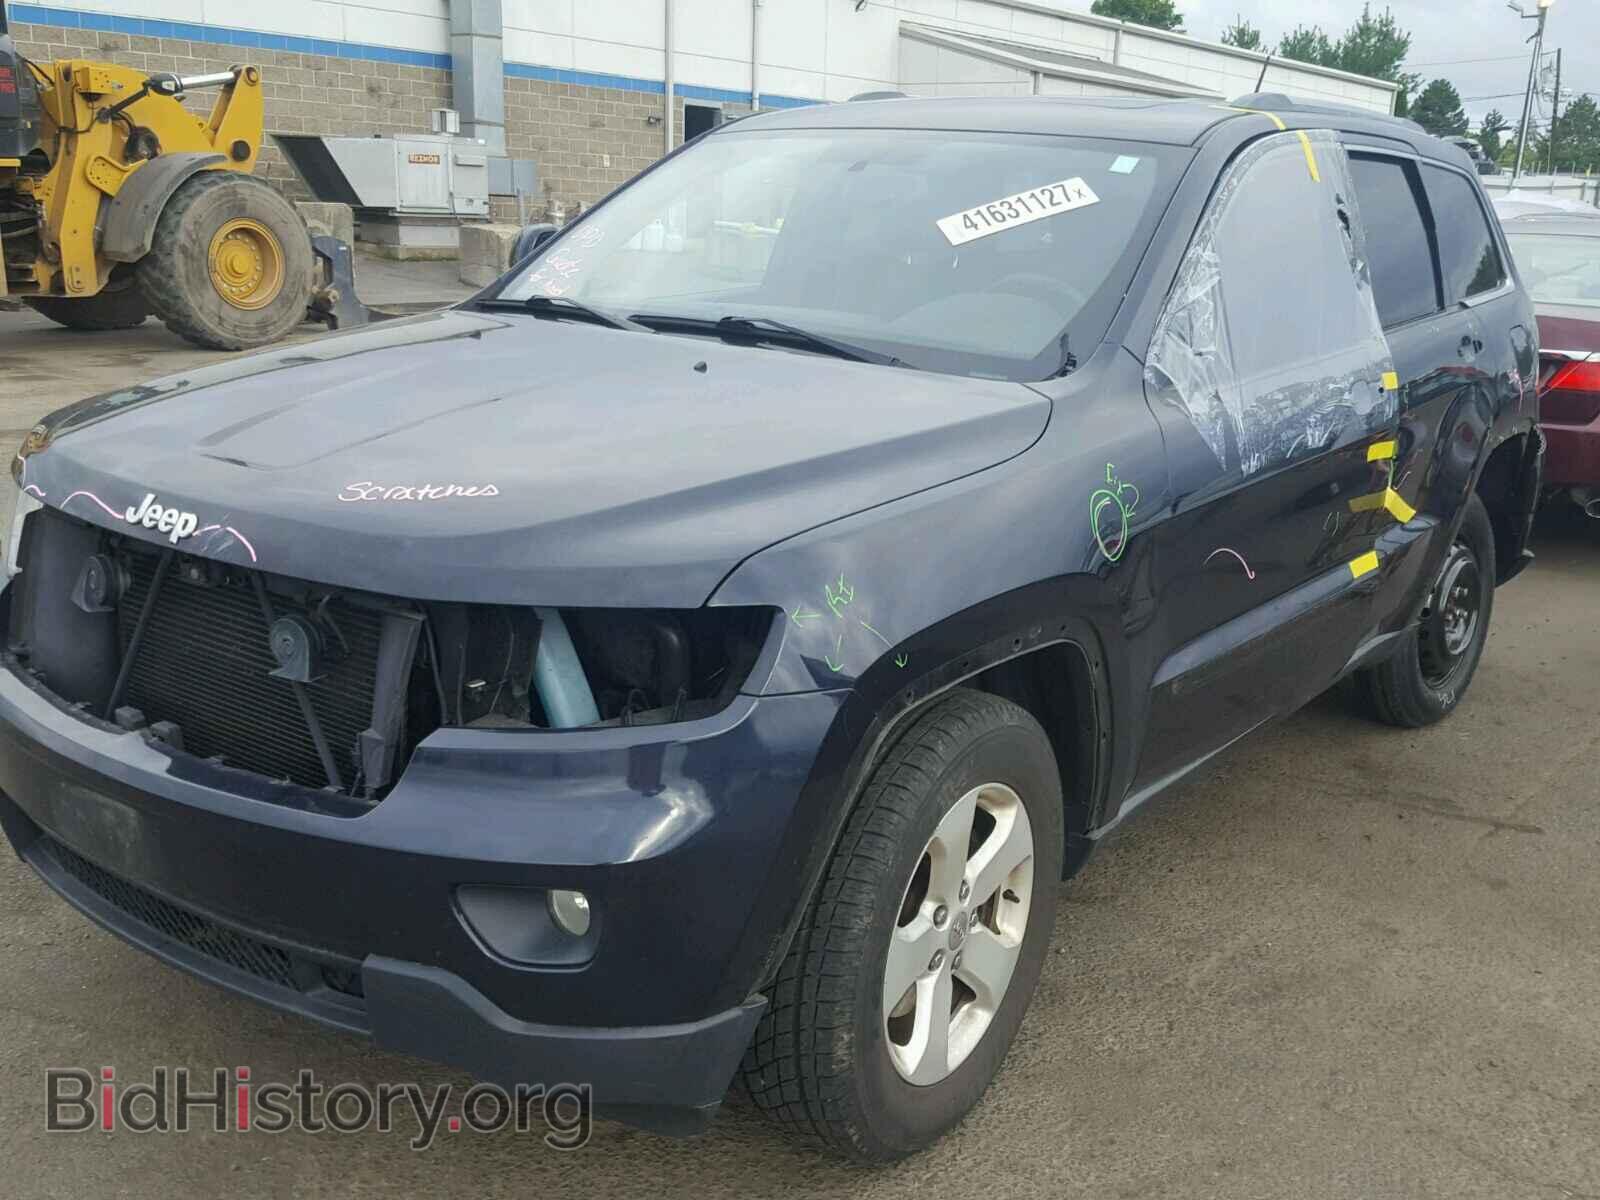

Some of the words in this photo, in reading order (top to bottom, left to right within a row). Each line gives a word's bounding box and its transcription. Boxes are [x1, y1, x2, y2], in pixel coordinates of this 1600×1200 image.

[962, 184, 1072, 231] 41631127
[338, 481, 499, 502] Scratches
[125, 493, 199, 545] Jeep
